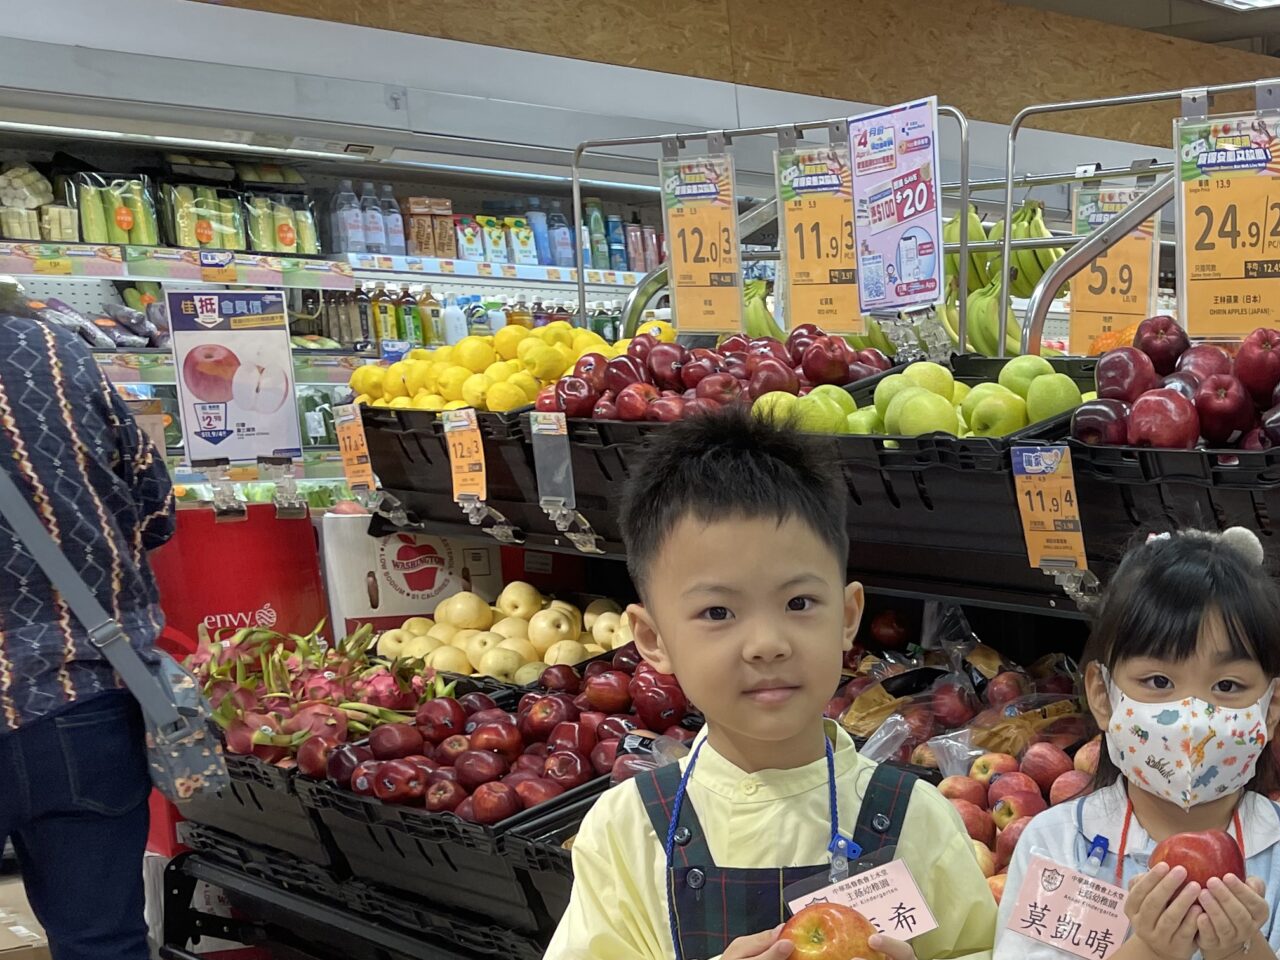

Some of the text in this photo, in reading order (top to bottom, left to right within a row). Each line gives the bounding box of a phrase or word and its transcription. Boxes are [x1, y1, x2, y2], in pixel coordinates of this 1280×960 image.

[857, 129, 868, 149] 4
[1215, 179, 1231, 189] 13.9
[895, 182, 928, 218] $20
[1088, 249, 1133, 295] 5.9
[392, 554, 445, 571] WASHINGTON
[204, 611, 253, 629] envy
[1020, 902, 1115, 959] 莫凱晴
